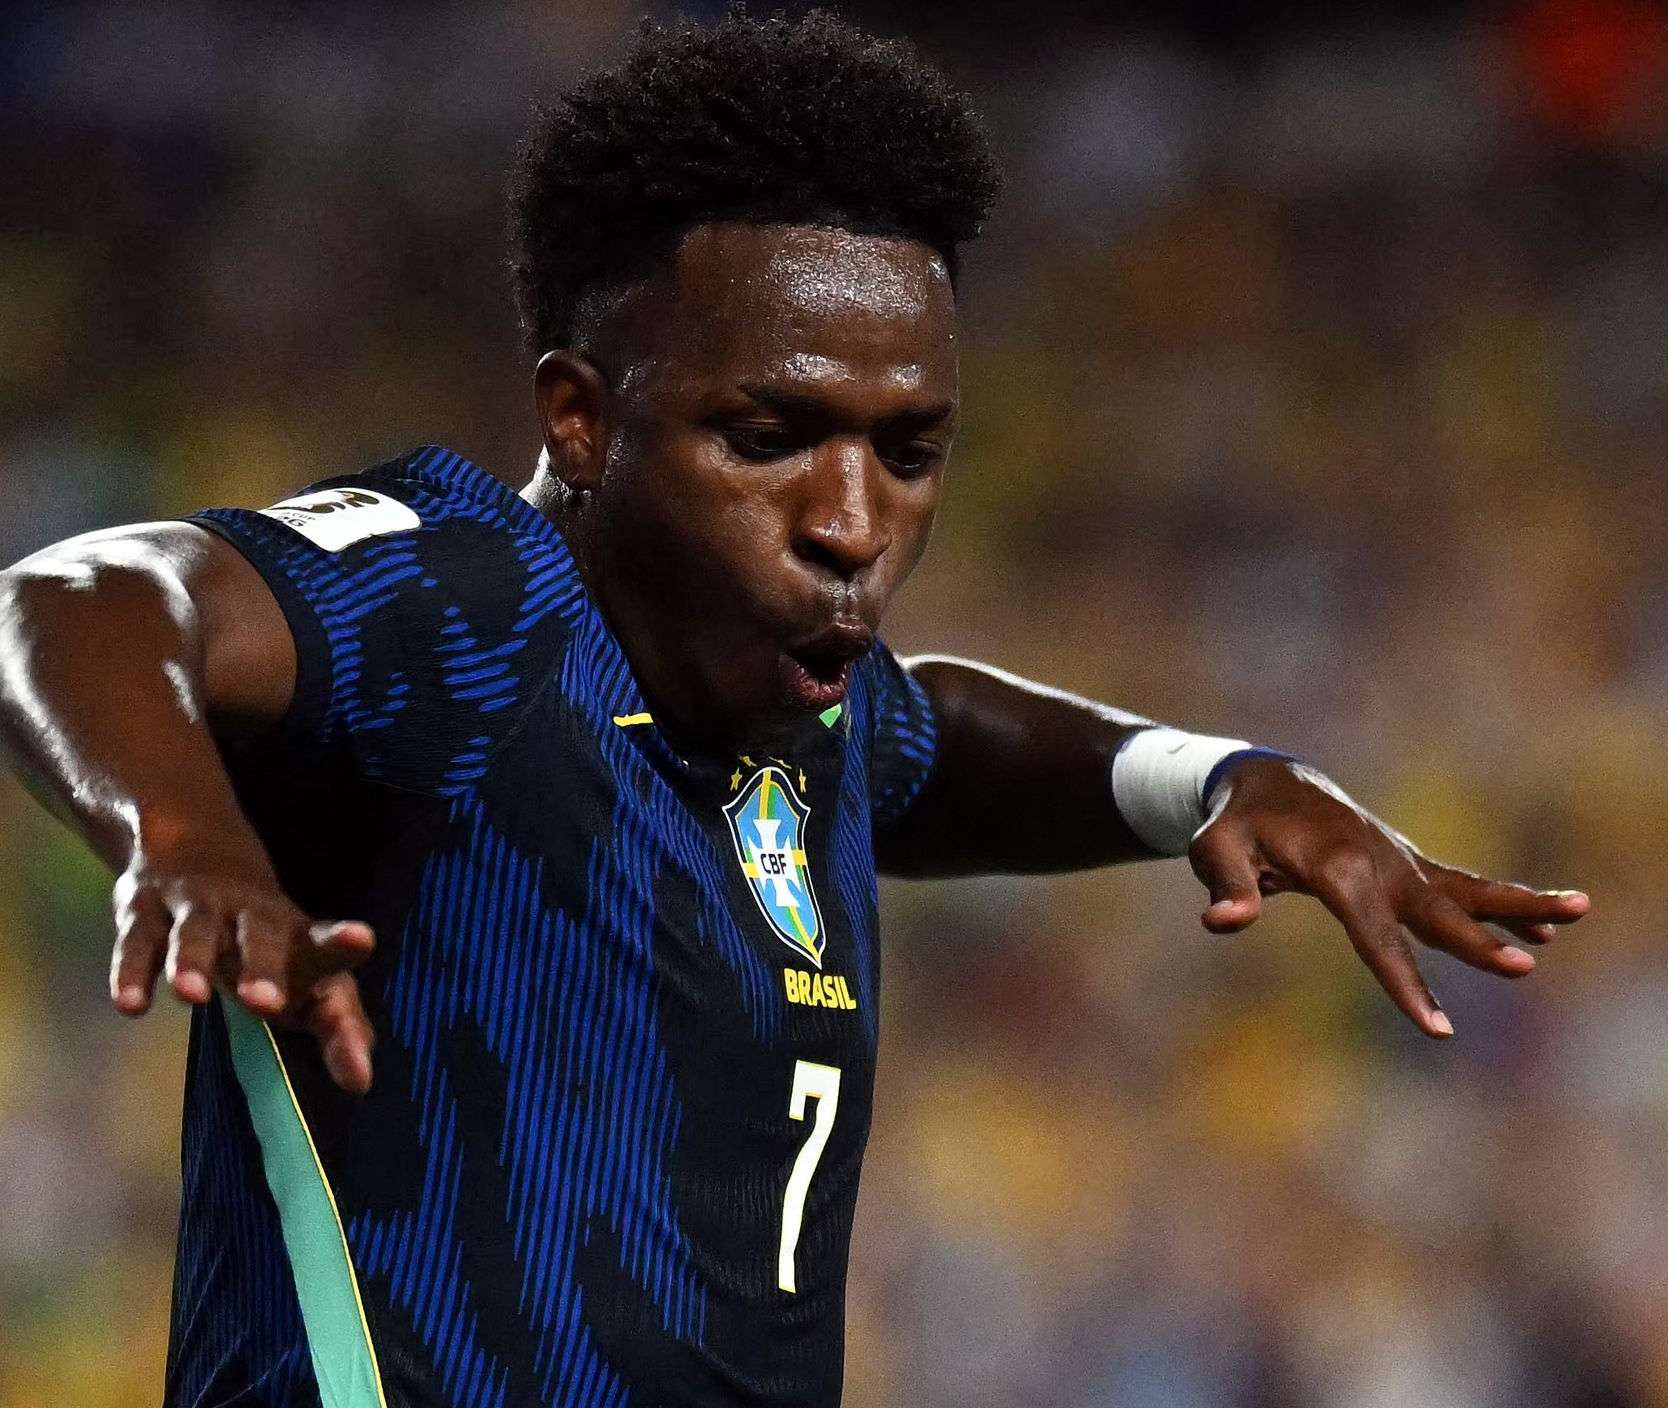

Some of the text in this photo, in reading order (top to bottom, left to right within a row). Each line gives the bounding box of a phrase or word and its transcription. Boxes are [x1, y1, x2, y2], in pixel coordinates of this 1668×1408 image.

[760, 853, 787, 875] CBF
[783, 967, 857, 1010] BRASIL
[777, 1059, 842, 1294] 7
